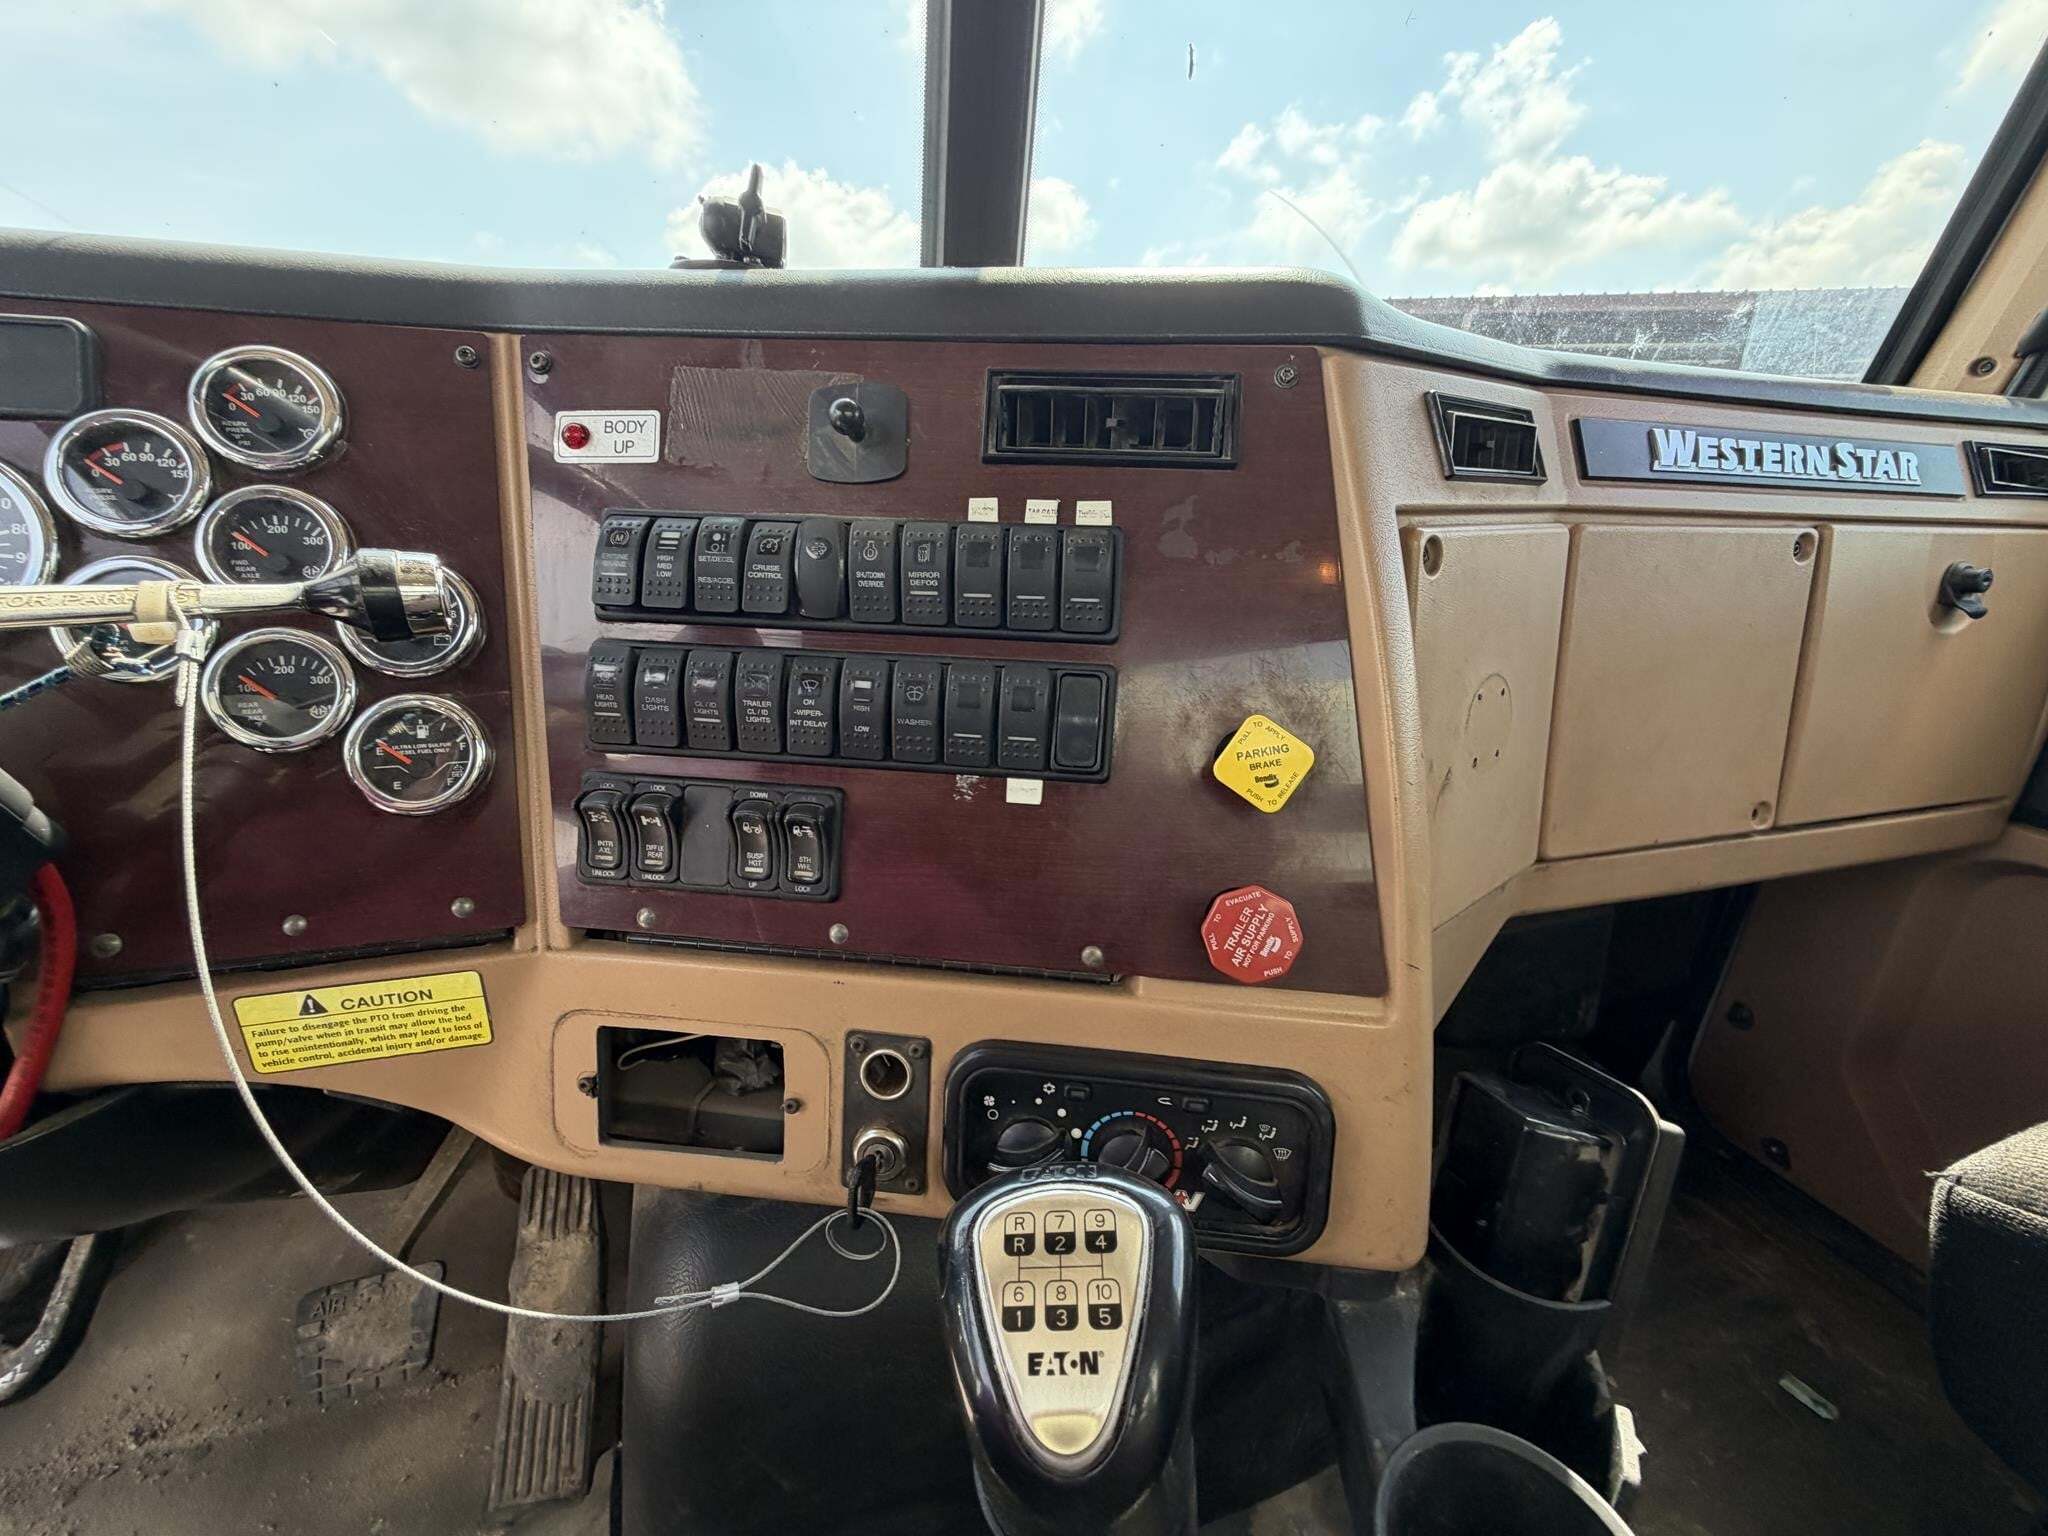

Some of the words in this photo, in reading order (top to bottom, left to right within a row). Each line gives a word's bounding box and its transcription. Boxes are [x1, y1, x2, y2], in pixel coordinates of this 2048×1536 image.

[240, 392, 254, 401] 30
[256, 388, 270, 397] 60
[288, 394, 306, 403] 120
[302, 406, 320, 414] 150
[604, 420, 647, 434] BODY
[614, 440, 634, 454] UP
[122, 453, 137, 462] 60
[139, 453, 154, 462] 90
[1650, 428, 1831, 477] WESTERN
[1831, 442, 1922, 484] STAR
[104, 458, 120, 467] 30
[156, 458, 176, 467] 120
[92, 470, 100, 478] 0
[267, 525, 288, 534] 200
[231, 542, 252, 550] 100
[302, 536, 324, 546] 300
[656, 562, 672, 570] MED
[752, 564, 780, 572] CRUISE
[656, 570, 672, 578] LOW
[747, 572, 784, 580] CONTROL
[858, 580, 885, 588] OVERRIDE
[274, 666, 295, 674] 200
[310, 676, 330, 684] 300
[644, 696, 666, 704] DASH
[742, 700, 772, 708] TRAILER
[642, 704, 670, 712] LIGHTS
[694, 708, 720, 716] LIGHTS
[746, 716, 772, 724] LIGHTS
[803, 720, 828, 728] DELAY
[896, 718, 934, 726] WASHER
[1238, 730, 1252, 745] PULL
[1265, 726, 1286, 741] APPLY
[376, 747, 384, 756] E
[460, 742, 466, 751] F
[1236, 744, 1290, 762] PARKING
[1249, 758, 1282, 772] BRAKE
[1254, 774, 1277, 784] Bendix
[393, 782, 402, 790] E
[650, 784, 666, 792] LOCK
[1246, 788, 1264, 802] PUSH
[1278, 772, 1299, 800] RELEASE
[746, 852, 764, 860] SUSP
[1225, 891, 1261, 906] EVACUATE
[1213, 914, 1222, 922] TO
[1224, 906, 1254, 952] TRAILER
[1285, 917, 1299, 944] SUPPLY
[1232, 947, 1247, 967] AIR
[1242, 904, 1270, 947] SUPPLY
[1242, 954, 1254, 968] NOT
[1250, 940, 1260, 954] FOR
[1257, 912, 1275, 940] PARKING
[1208, 932, 1219, 951] PULL
[1284, 950, 1293, 960] TO
[1264, 966, 1283, 977] PUSH
[341, 988, 433, 1010] CAUTION
[251, 1027, 287, 1038] Failure
[289, 1026, 300, 1034] to
[302, 1020, 350, 1033] disengage
[352, 1017, 368, 1025] the
[370, 1014, 390, 1022] PTO
[392, 1012, 414, 1020] from
[418, 1007, 448, 1018] driving
[451, 1004, 466, 1012] the
[255, 1035, 313, 1050] pump/valve
[316, 1030, 342, 1040] when
[344, 1028, 354, 1036] in
[356, 1024, 386, 1035] transit
[389, 1022, 408, 1032] may
[411, 1018, 436, 1028] allow
[438, 1016, 453, 1024] the
[454, 1013, 472, 1021] bed
[258, 1050, 269, 1058] to
[272, 1048, 290, 1056] rise
[292, 1038, 368, 1054] unintentionally,
[370, 1032, 396, 1043] which
[399, 1031, 418, 1040] may
[421, 1027, 440, 1036] lead
[442, 1025, 452, 1033] to
[454, 1022, 472, 1032] loss
[474, 1021, 483, 1029] of
[261, 1058, 296, 1068] vehicle
[298, 1051, 335, 1063] control,
[338, 1045, 384, 1058] accidental
[386, 1042, 412, 1052] injury
[416, 1036, 446, 1048] and/or
[1014, 1216, 1026, 1232] R
[1054, 1214, 1065, 1230] 7
[1094, 1214, 1105, 1228] 9
[1014, 1238, 1026, 1252] R
[1055, 1236, 1066, 1252] 2
[1095, 1234, 1107, 1250] 4
[1014, 1286, 1024, 1302] 6
[1056, 1284, 1067, 1301] 8
[1095, 1284, 1112, 1300] 10
[1016, 1310, 1022, 1329] 1
[1056, 1309, 1068, 1326] 3
[1099, 1308, 1112, 1326] 5
[1028, 1351, 1100, 1377] EATON
